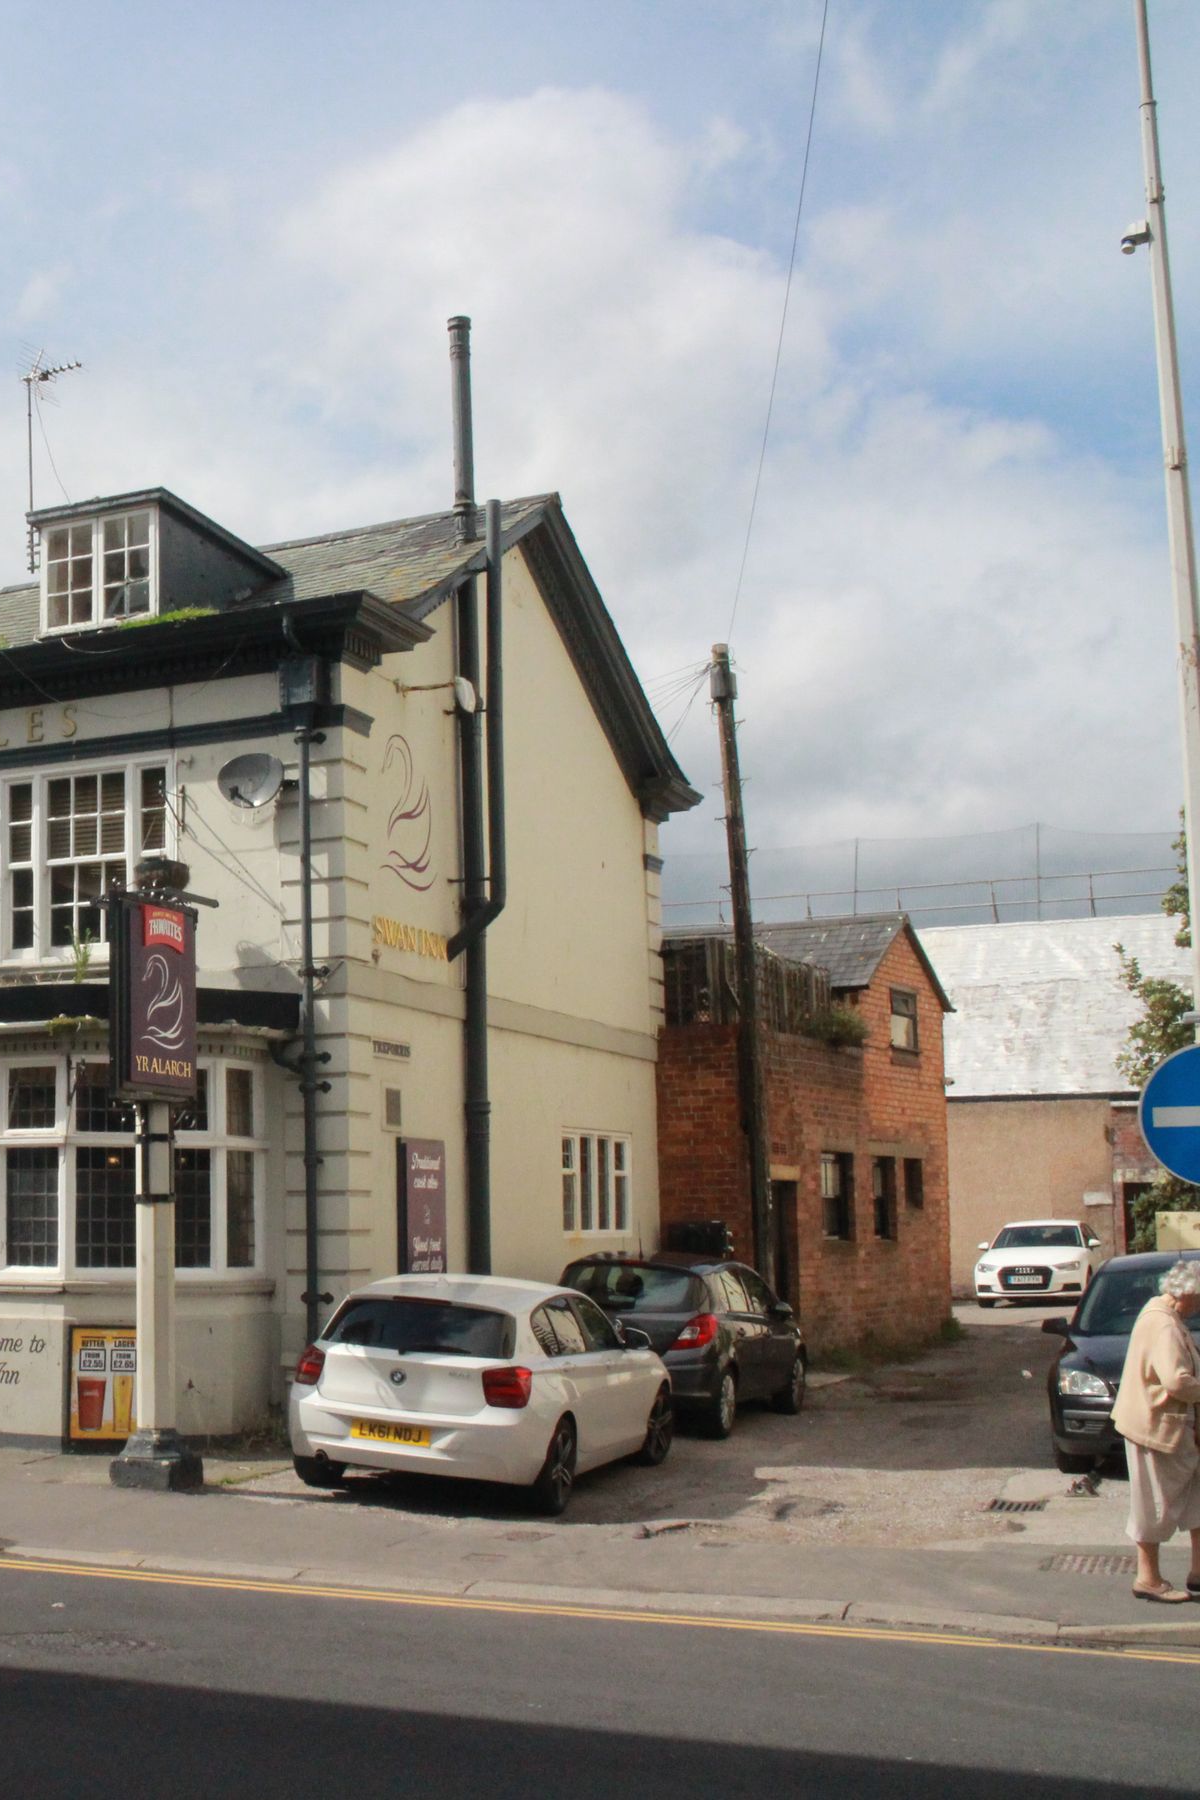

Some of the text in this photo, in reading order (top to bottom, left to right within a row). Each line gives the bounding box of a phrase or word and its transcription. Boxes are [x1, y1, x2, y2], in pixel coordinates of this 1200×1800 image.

[373, 915, 448, 960] SWAN INN
[136, 1054, 191, 1078] YR ALARCH
[29, 1334, 47, 1354] to
[358, 1422, 422, 1443] LK61 NDJ
